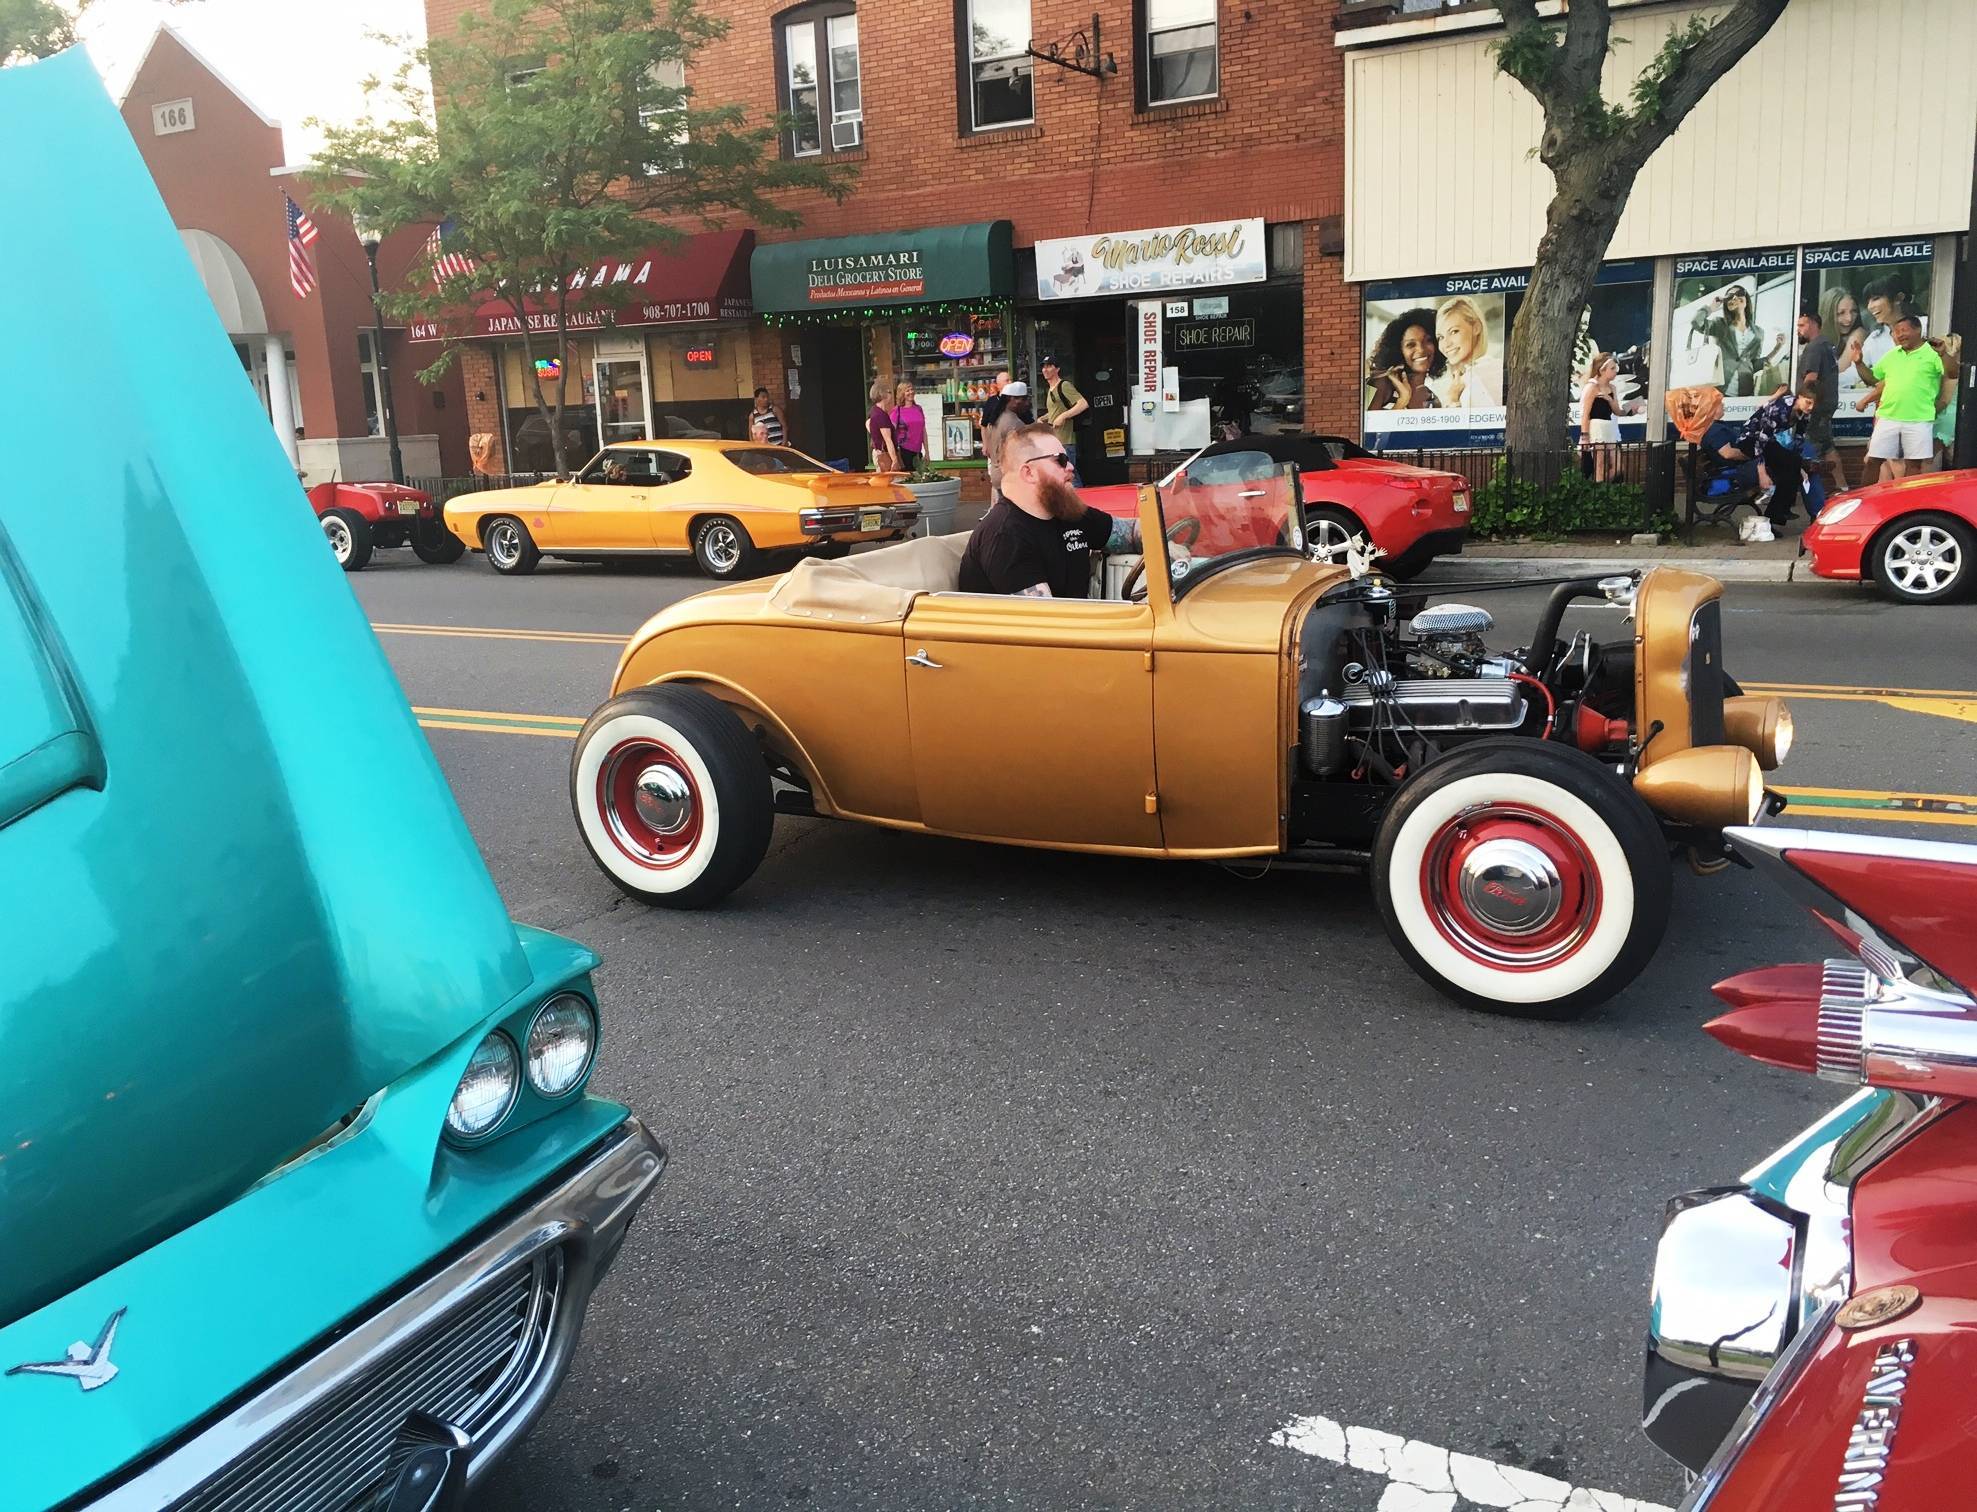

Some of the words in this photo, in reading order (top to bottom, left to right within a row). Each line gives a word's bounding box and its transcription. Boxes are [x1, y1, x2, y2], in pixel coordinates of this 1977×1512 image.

[160, 107, 186, 128] 166
[1091, 233, 1175, 272] Mario
[1172, 224, 1245, 266] Rossi
[1805, 250, 1850, 264] SPACE
[1853, 244, 1932, 260] AVAILABLE
[811, 251, 919, 271] LUISAMARI
[1676, 260, 1718, 273] SPACE
[1721, 254, 1795, 270] AVAILABLE
[808, 273, 833, 287] DELI
[836, 270, 886, 285] GROCERY
[888, 267, 923, 282] STORE
[1109, 271, 1150, 290] SHOE
[1160, 265, 1235, 287] REPAIRS
[1446, 279, 1489, 292] SPACE
[1491, 277, 1529, 291] AVAIL
[643, 302, 710, 320] 908-707-1700
[1169, 305, 1186, 314] 158
[410, 325, 426, 338] 164
[428, 323, 438, 337] W
[488, 314, 541, 332] JAPANSE
[1143, 312, 1157, 345] SHOE
[1180, 327, 1209, 345] SHOE
[1212, 324, 1251, 343] REPAIR
[940, 338, 972, 352] OPEN
[687, 350, 712, 362] OPEN
[537, 367, 560, 378] SUSHI
[1143, 350, 1157, 393] REPAIR
[1397, 416, 1418, 426] (732)
[1421, 414, 1460, 425] 985-1900
[1469, 413, 1506, 424] EDGEW
